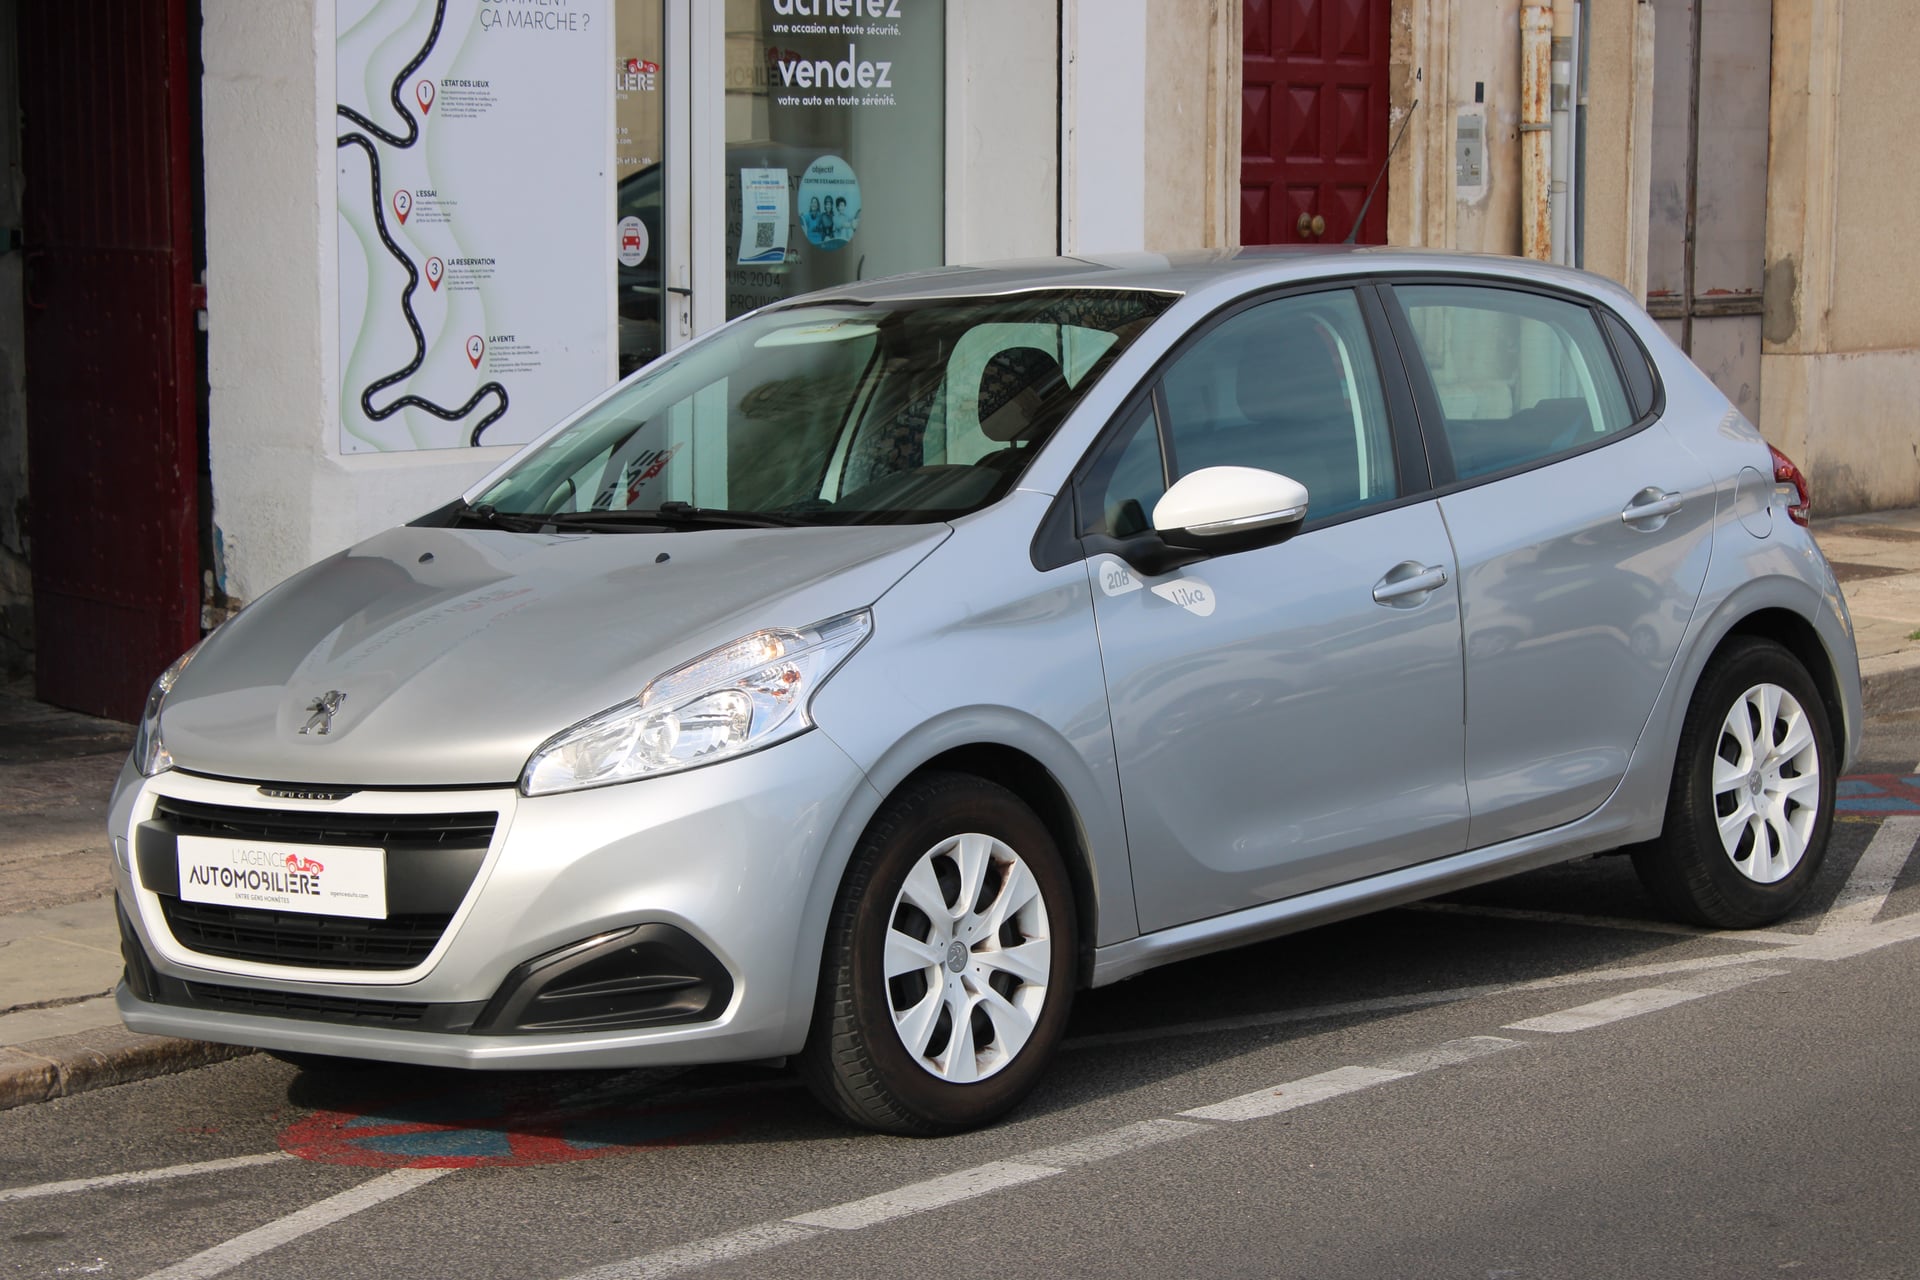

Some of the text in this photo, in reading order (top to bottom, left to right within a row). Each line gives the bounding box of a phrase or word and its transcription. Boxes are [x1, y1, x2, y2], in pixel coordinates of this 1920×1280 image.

[480, 8, 590, 32] ÇA MARCHE ?
[773, 22, 902, 36] une occasion en toute sécurité.
[777, 43, 892, 89] vendez
[1416, 67, 1422, 82] 4
[459, 80, 471, 88] DES
[472, 80, 490, 88] LIEUX
[423, 86, 428, 98] 1
[778, 93, 897, 107] votre auto en toute sérénité.
[400, 196, 406, 209] 2
[431, 262, 438, 276] 3
[447, 258, 496, 266] LA RESERVATION
[489, 335, 496, 343] LA
[472, 341, 479, 353] 4
[1107, 570, 1130, 590] 208
[271, 790, 335, 800] PEUGEOT
[232, 849, 287, 868] L'AGENCE
[190, 865, 321, 896] AUTOMOBILIERE
[235, 892, 250, 901] ENTRE
[251, 893, 263, 902] GENS
